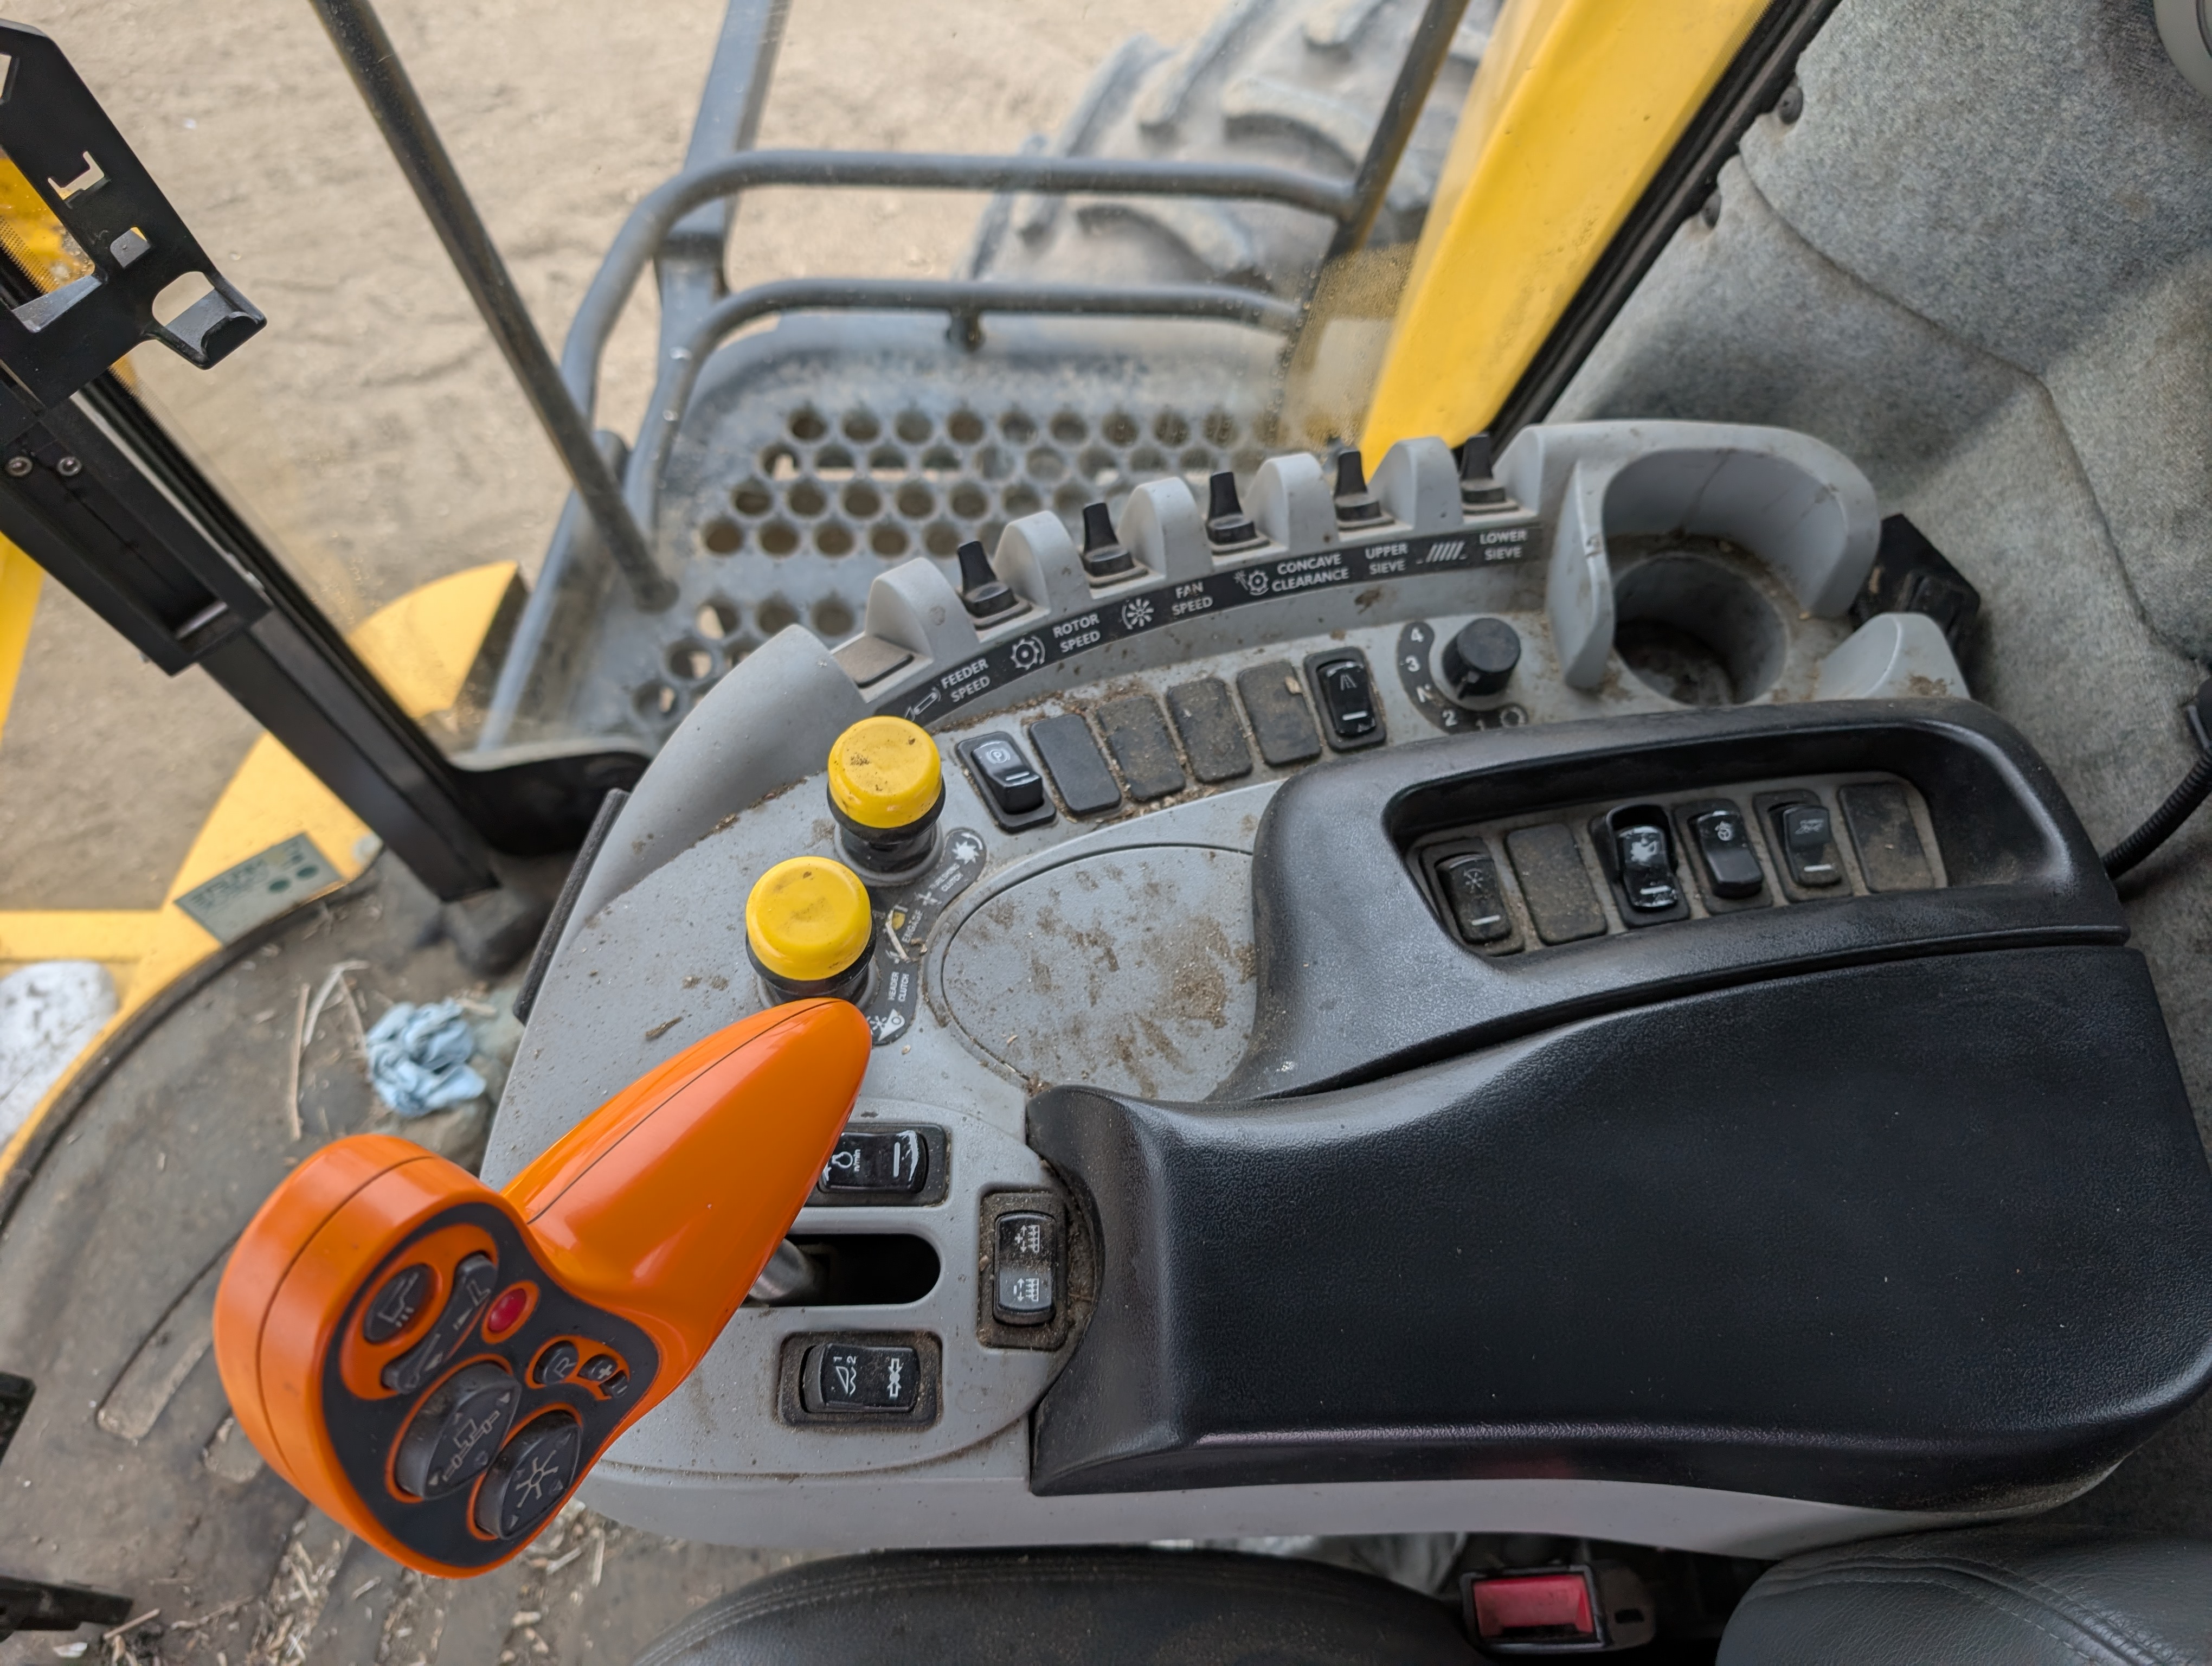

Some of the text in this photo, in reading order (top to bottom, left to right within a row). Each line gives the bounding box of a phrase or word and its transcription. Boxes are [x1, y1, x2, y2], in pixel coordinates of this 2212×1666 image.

[1480, 529, 1528, 545] LOWER
[1365, 543, 1409, 560] UPPER
[1484, 546, 1522, 561] SIEVE
[1277, 553, 1342, 575] CONCAVE
[1368, 559, 1407, 575] SIEVE
[1175, 581, 1204, 598] FAN
[1271, 568, 1349, 593] CLEARANCE
[1171, 596, 1213, 616] SPEED
[1052, 613, 1100, 638] ROTOR
[1411, 627, 1424, 643] 4
[1060, 630, 1101, 653] SPEED
[940, 658, 989, 690] FEEDER
[1406, 655, 1420, 672] 3
[950, 675, 991, 703] SPEED
[1442, 709, 1458, 727] 2
[941, 871, 964, 892] CLUTCH
[888, 971, 899, 1001] HEADER
[898, 973, 910, 1002] CLUTCH
[853, 1149, 861, 1172] n/min
[554, 1357, 577, 1378] R
[846, 1355, 857, 1364] 2
